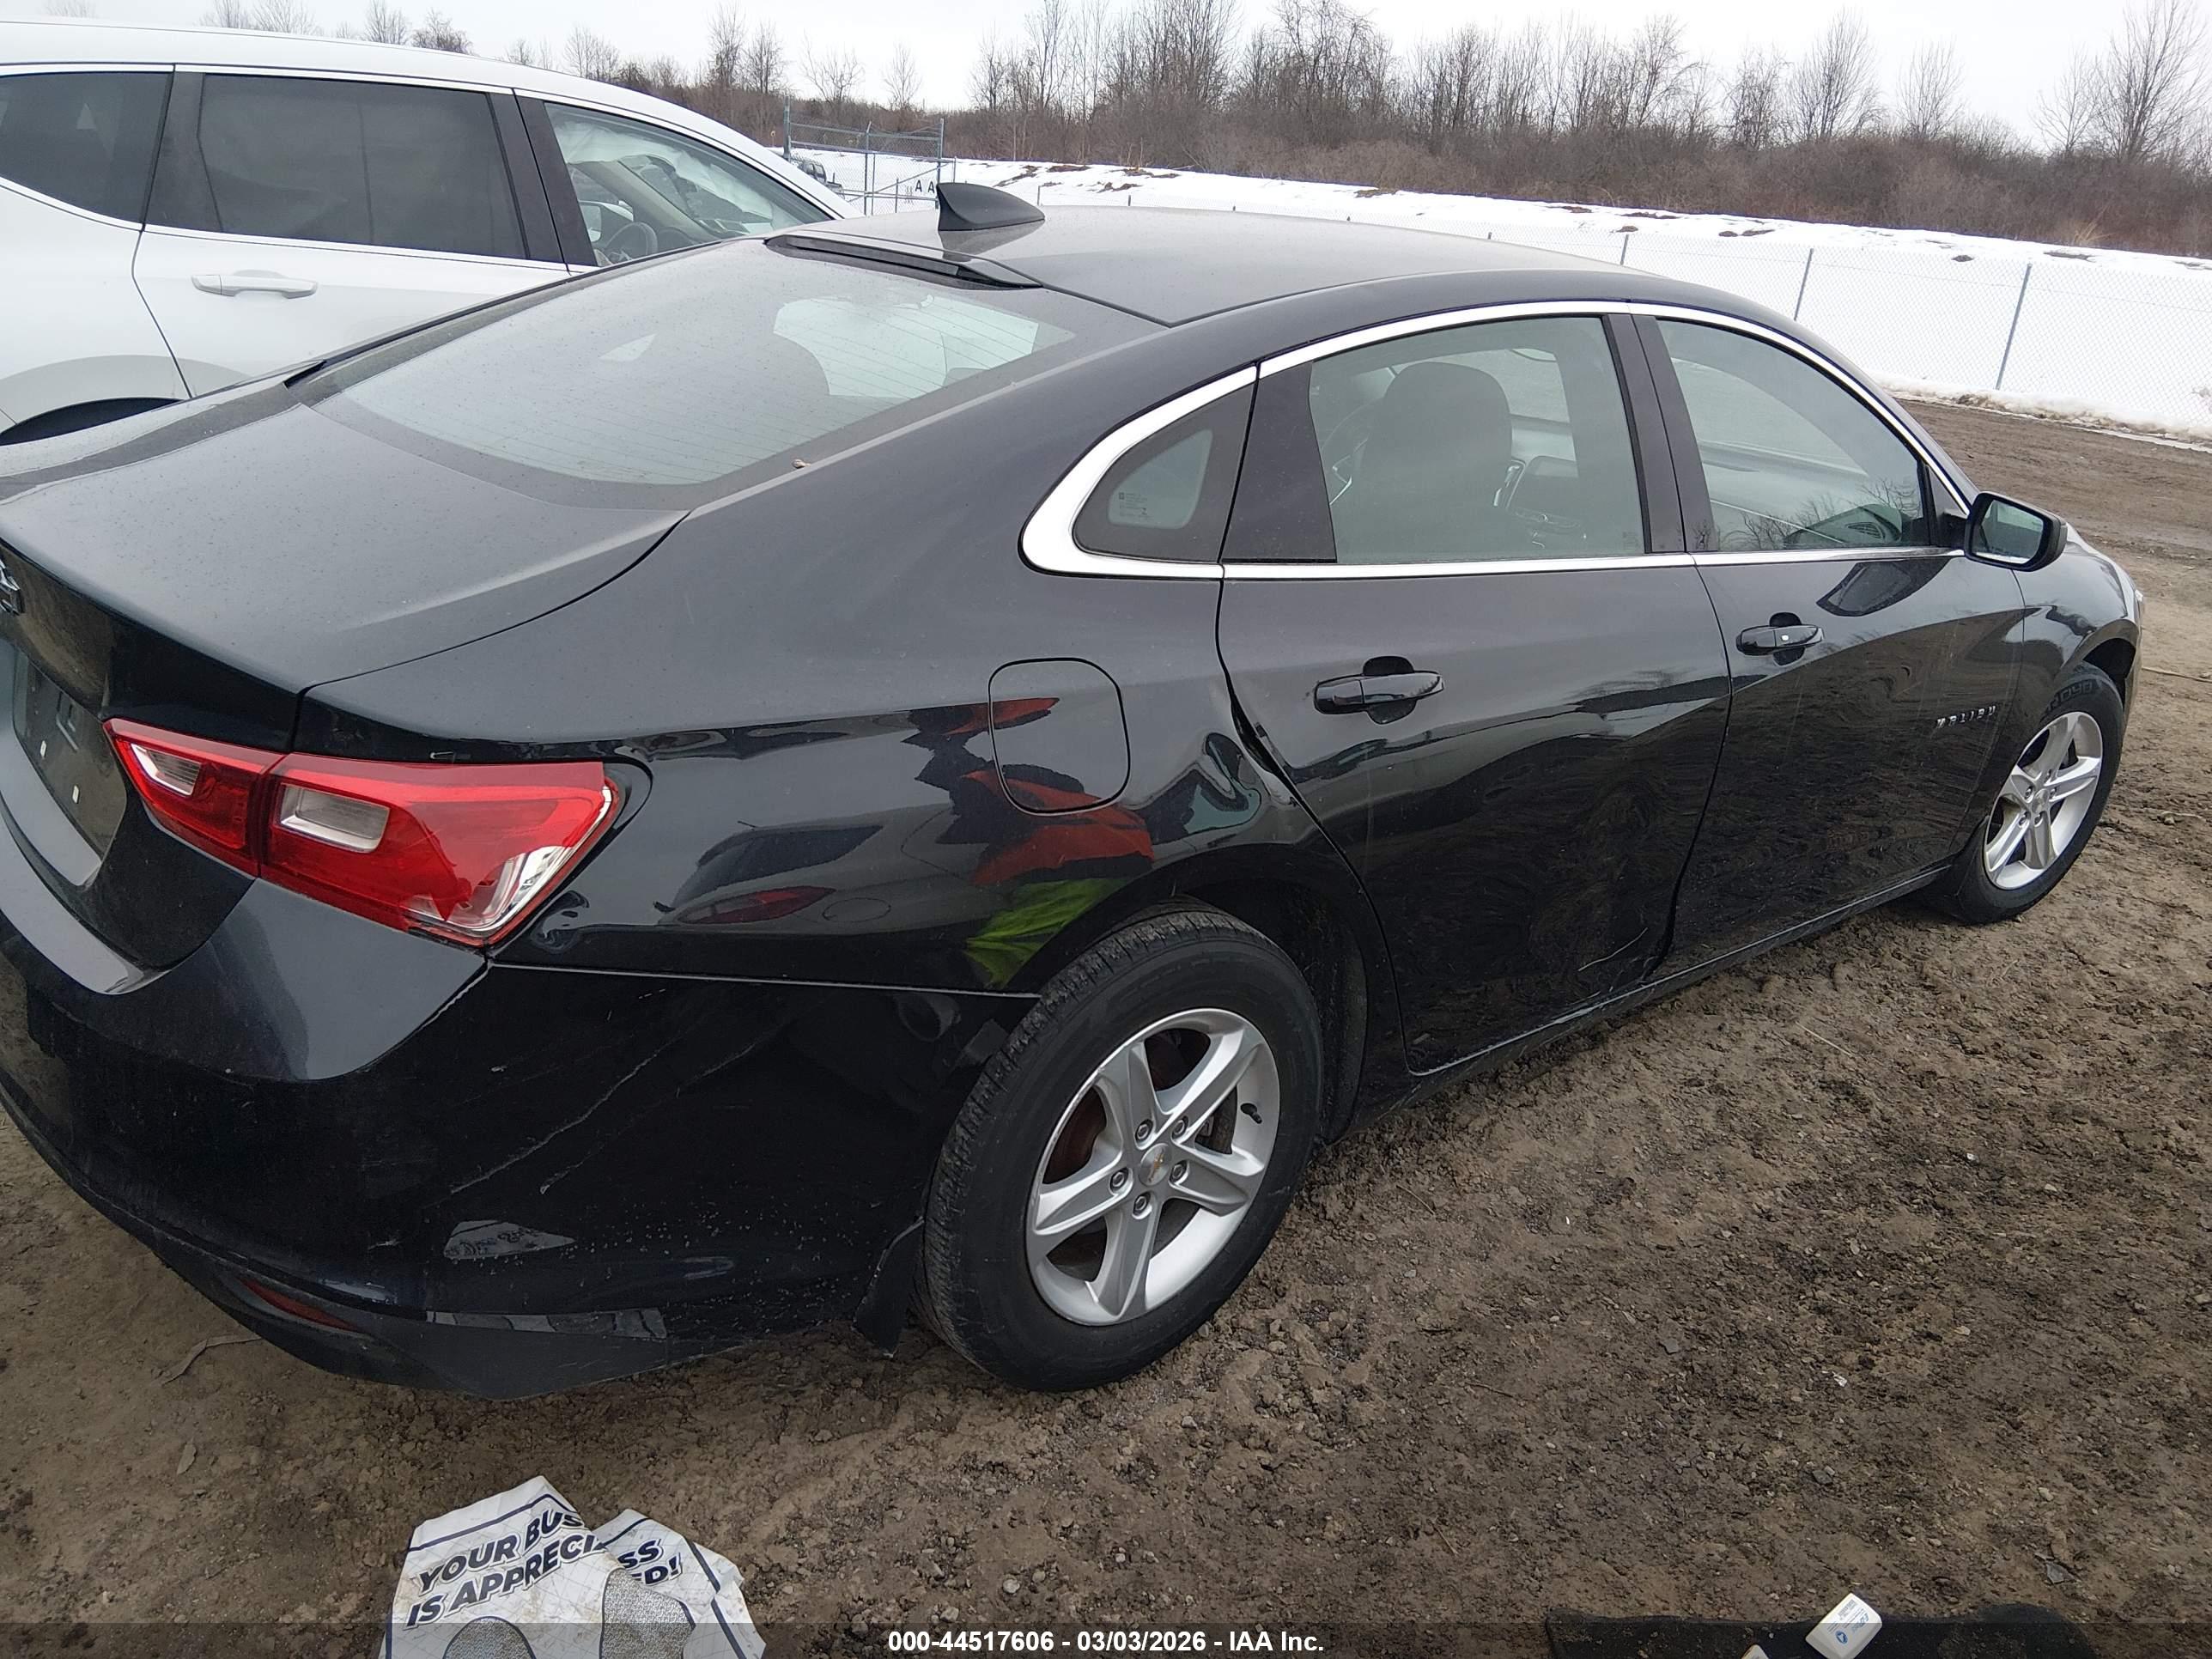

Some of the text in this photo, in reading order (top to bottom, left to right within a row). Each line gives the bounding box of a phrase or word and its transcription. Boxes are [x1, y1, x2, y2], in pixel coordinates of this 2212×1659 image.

[1936, 705, 1996, 728] MALIBU
[417, 1534, 518, 1592] YOUR
[404, 1595, 444, 1627] IS
